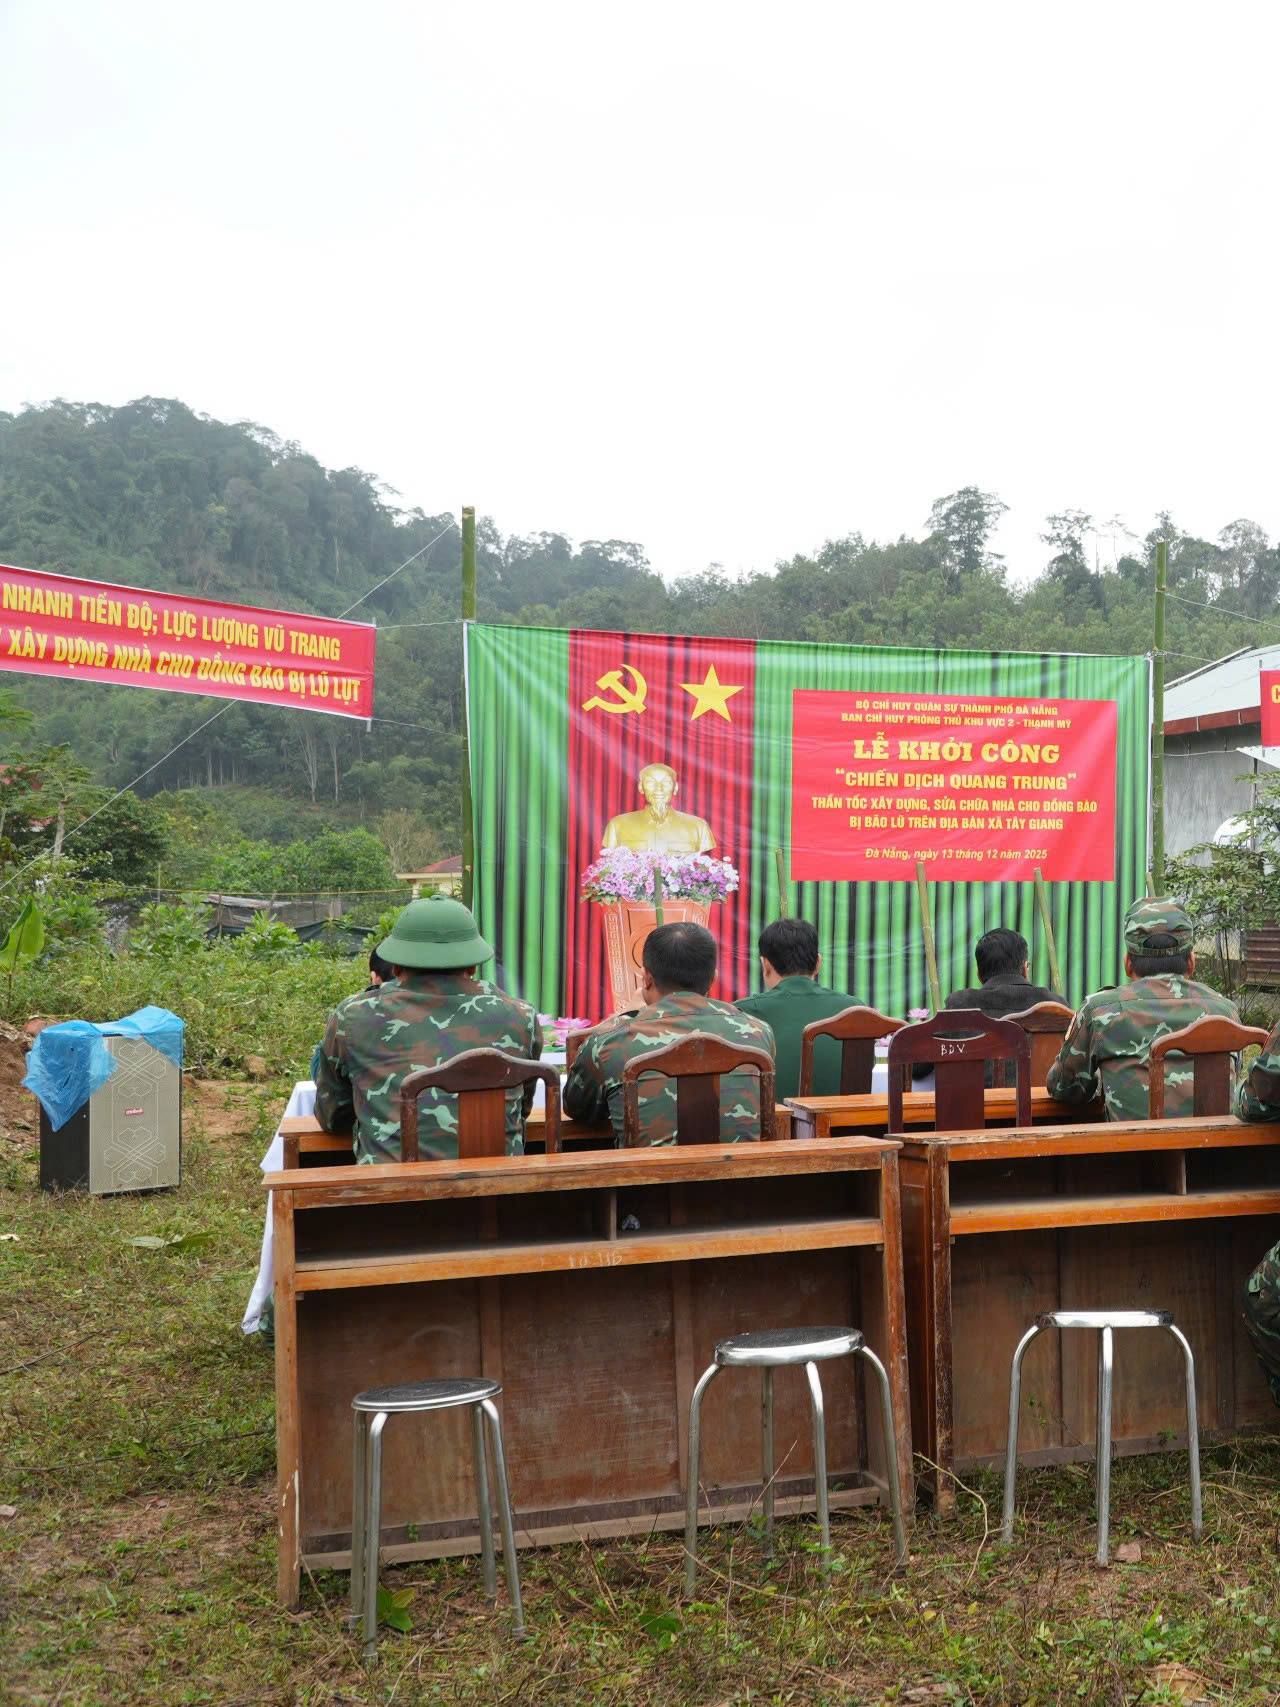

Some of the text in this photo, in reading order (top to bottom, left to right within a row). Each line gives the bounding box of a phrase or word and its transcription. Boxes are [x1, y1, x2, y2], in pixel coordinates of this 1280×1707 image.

[2, 582, 341, 661] NHANH TIẾN ĐỘ; LỰC LƯỢNG VŨ TRANG
[8, 626, 48, 660] XÂY
[52, 634, 109, 669] DỰNG
[114, 642, 151, 672] NHÀ
[156, 651, 192, 679] CHO
[197, 651, 246, 686] ĐỒNG
[250, 661, 284, 692] BÀO
[289, 671, 305, 699] BỊ
[310, 672, 329, 698] LŨ
[333, 679, 361, 706] LỤT
[855, 700, 869, 712] BỘ
[892, 702, 912, 711] HUY
[944, 703, 958, 714] SỰ
[959, 703, 992, 714] THÀNH
[994, 703, 1013, 715] PHỐ
[841, 712, 863, 722] BAN
[885, 715, 905, 724] HUY
[963, 717, 984, 726] KHU
[986, 718, 1005, 729] VỰC
[1007, 719, 1014, 727] 2
[1023, 719, 1054, 730] THẠNH
[854, 732, 1060, 764] LỄ KHỞI CÔNG
[904, 773, 945, 791] DỊCH
[950, 775, 1007, 790] QUANG
[846, 794, 867, 810] TỐC
[870, 795, 893, 810] XÂY
[934, 794, 956, 811] SỬA
[959, 797, 989, 811] CHỮA
[992, 797, 1015, 812] NHÀ
[1017, 800, 1040, 812] CHO
[849, 816, 862, 831] BỊ
[908, 817, 936, 830] TRÊN
[939, 818, 958, 831] ĐỊA
[1005, 816, 1026, 830] TÂY
[1028, 819, 1063, 830] GIANG
[865, 849, 879, 858] Đà
[913, 849, 939, 860] ngày
[942, 850, 953, 859] 13
[955, 850, 984, 862] tháng
[986, 851, 997, 859] 12
[1000, 852, 1022, 860] năm
[1024, 850, 1048, 860] 2025
